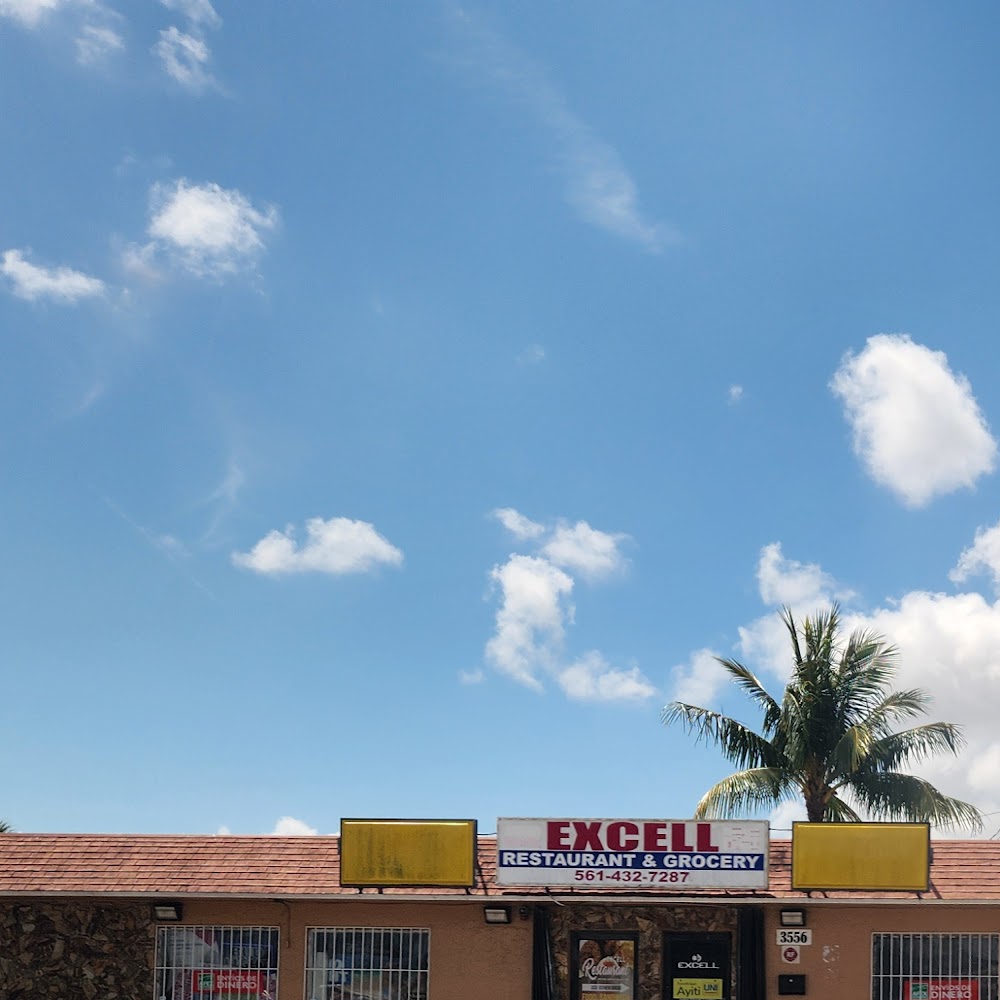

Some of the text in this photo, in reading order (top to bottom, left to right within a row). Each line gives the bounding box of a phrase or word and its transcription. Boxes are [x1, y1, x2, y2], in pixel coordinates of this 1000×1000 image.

[546, 821, 719, 852] EXCELL
[502, 852, 761, 869] RESTAURANT & GROCERY
[574, 870, 690, 883] 561-432-7287
[780, 931, 808, 943] 3556
[677, 961, 720, 969] EXCELL
[216, 981, 257, 989] DINERO
[703, 984, 719, 992] UNI
[676, 986, 701, 998] Ayiti
[930, 991, 972, 999] DINERO
